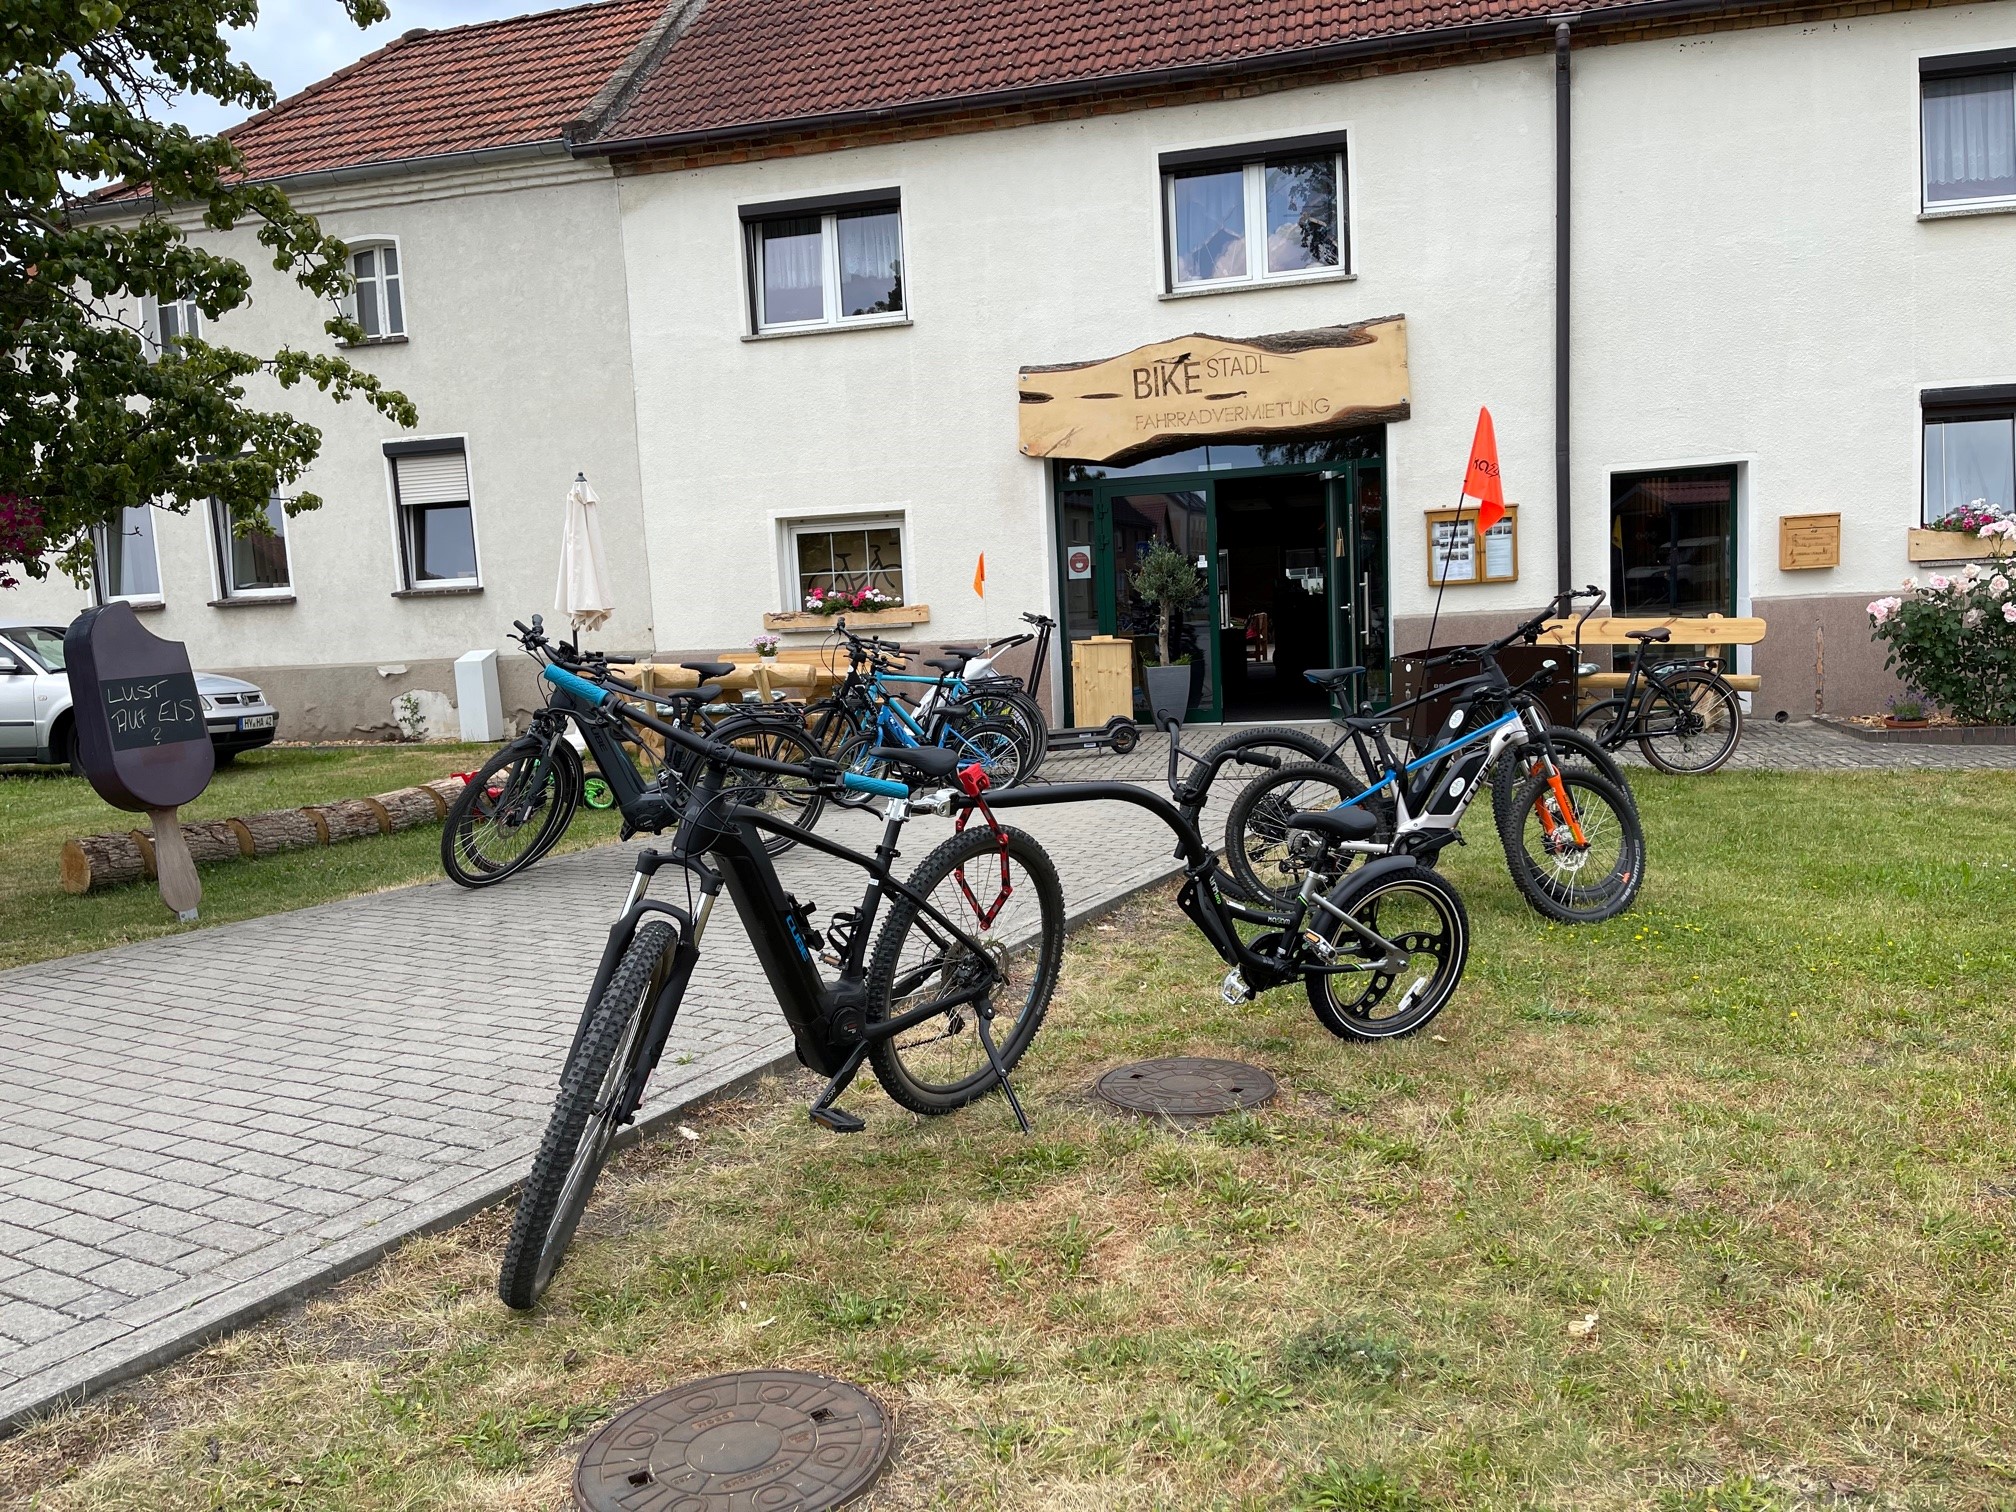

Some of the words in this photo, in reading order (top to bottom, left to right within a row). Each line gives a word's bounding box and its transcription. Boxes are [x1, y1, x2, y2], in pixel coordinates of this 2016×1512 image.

[1133, 362, 1202, 399] BIKE
[1207, 355, 1270, 378] STADL
[1135, 398, 1330, 431] FAHRRADVERMIETUNG
[107, 679, 168, 704] LUST
[111, 706, 147, 733] AUF
[158, 699, 196, 723] EIS
[150, 726, 162, 746] ?
[1462, 754, 1495, 806] CUBE
[1620, 839, 1641, 903] SCHWALBE
[786, 914, 810, 963] CUBE
